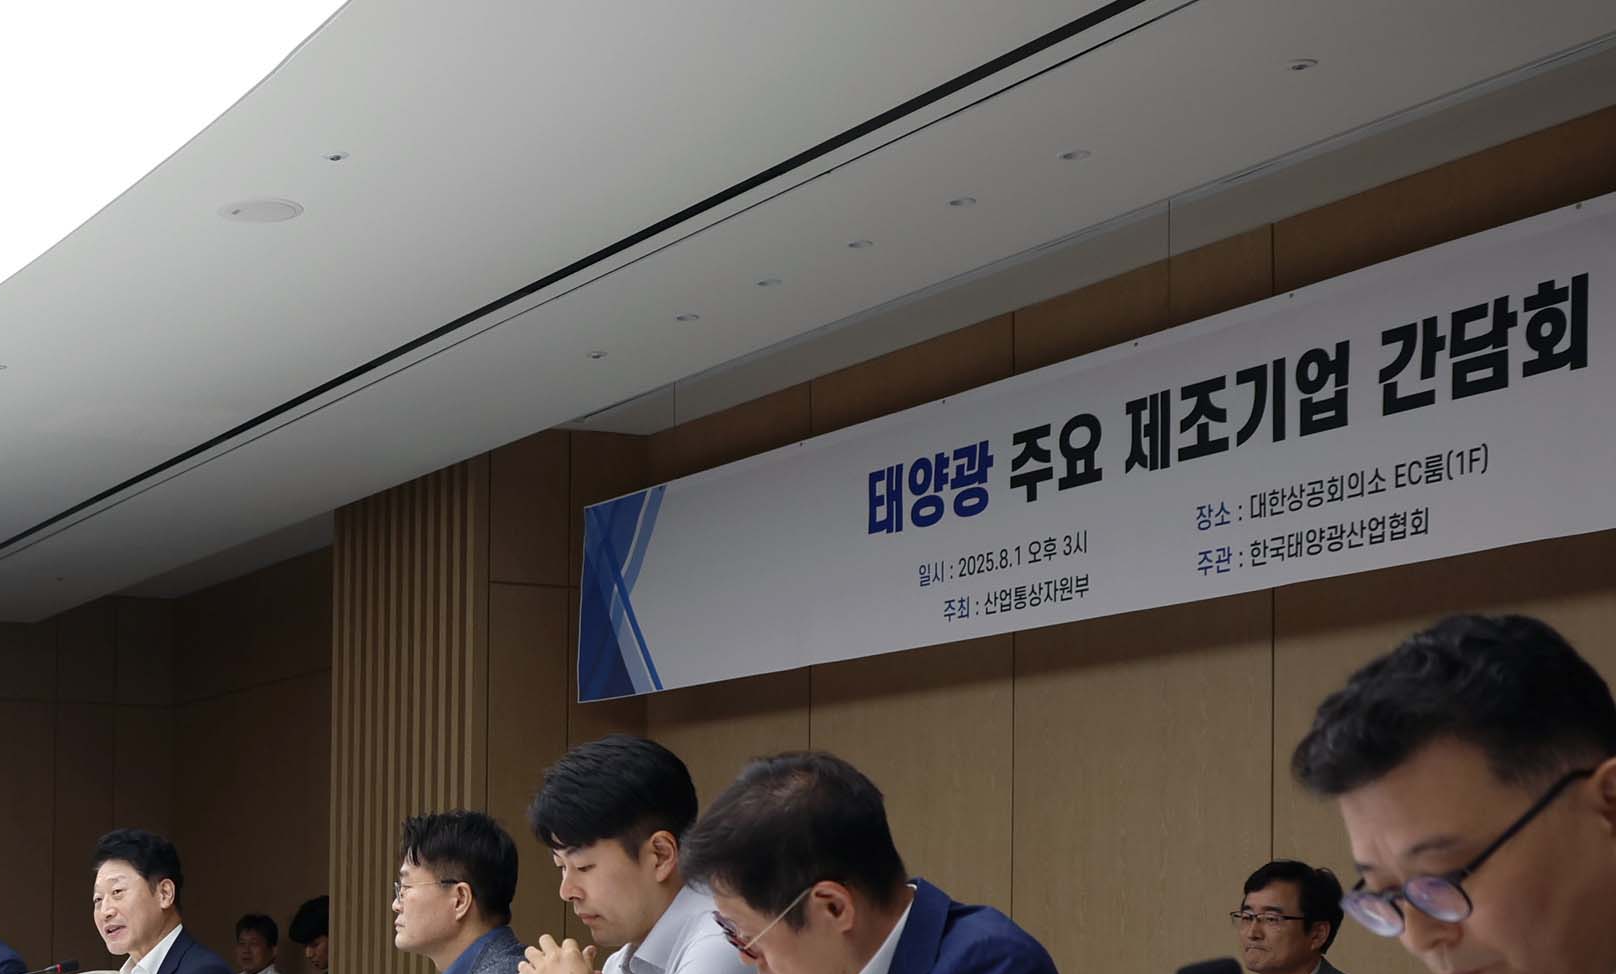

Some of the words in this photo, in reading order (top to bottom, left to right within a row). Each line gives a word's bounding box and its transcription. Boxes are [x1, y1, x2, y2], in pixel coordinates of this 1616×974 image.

[867, 440, 994, 536] 태양광
[1009, 412, 1104, 503] 주요
[1125, 339, 1351, 474] 제조기업
[1378, 272, 1590, 416] 간담회
[1196, 501, 1232, 531] 장소
[1250, 467, 1387, 520] 대한상공회의소
[1394, 443, 1489, 489] EC룸(1F)
[918, 561, 945, 587] 일시
[958, 545, 1022, 578] 2025.8.1
[1027, 536, 1057, 564] 오후
[1063, 530, 1088, 556] 3시
[1197, 546, 1233, 576] 주관
[1250, 507, 1430, 568] 한국태양광산업협회
[943, 595, 970, 622] 주최
[984, 573, 1090, 616] 산업통상자원부
